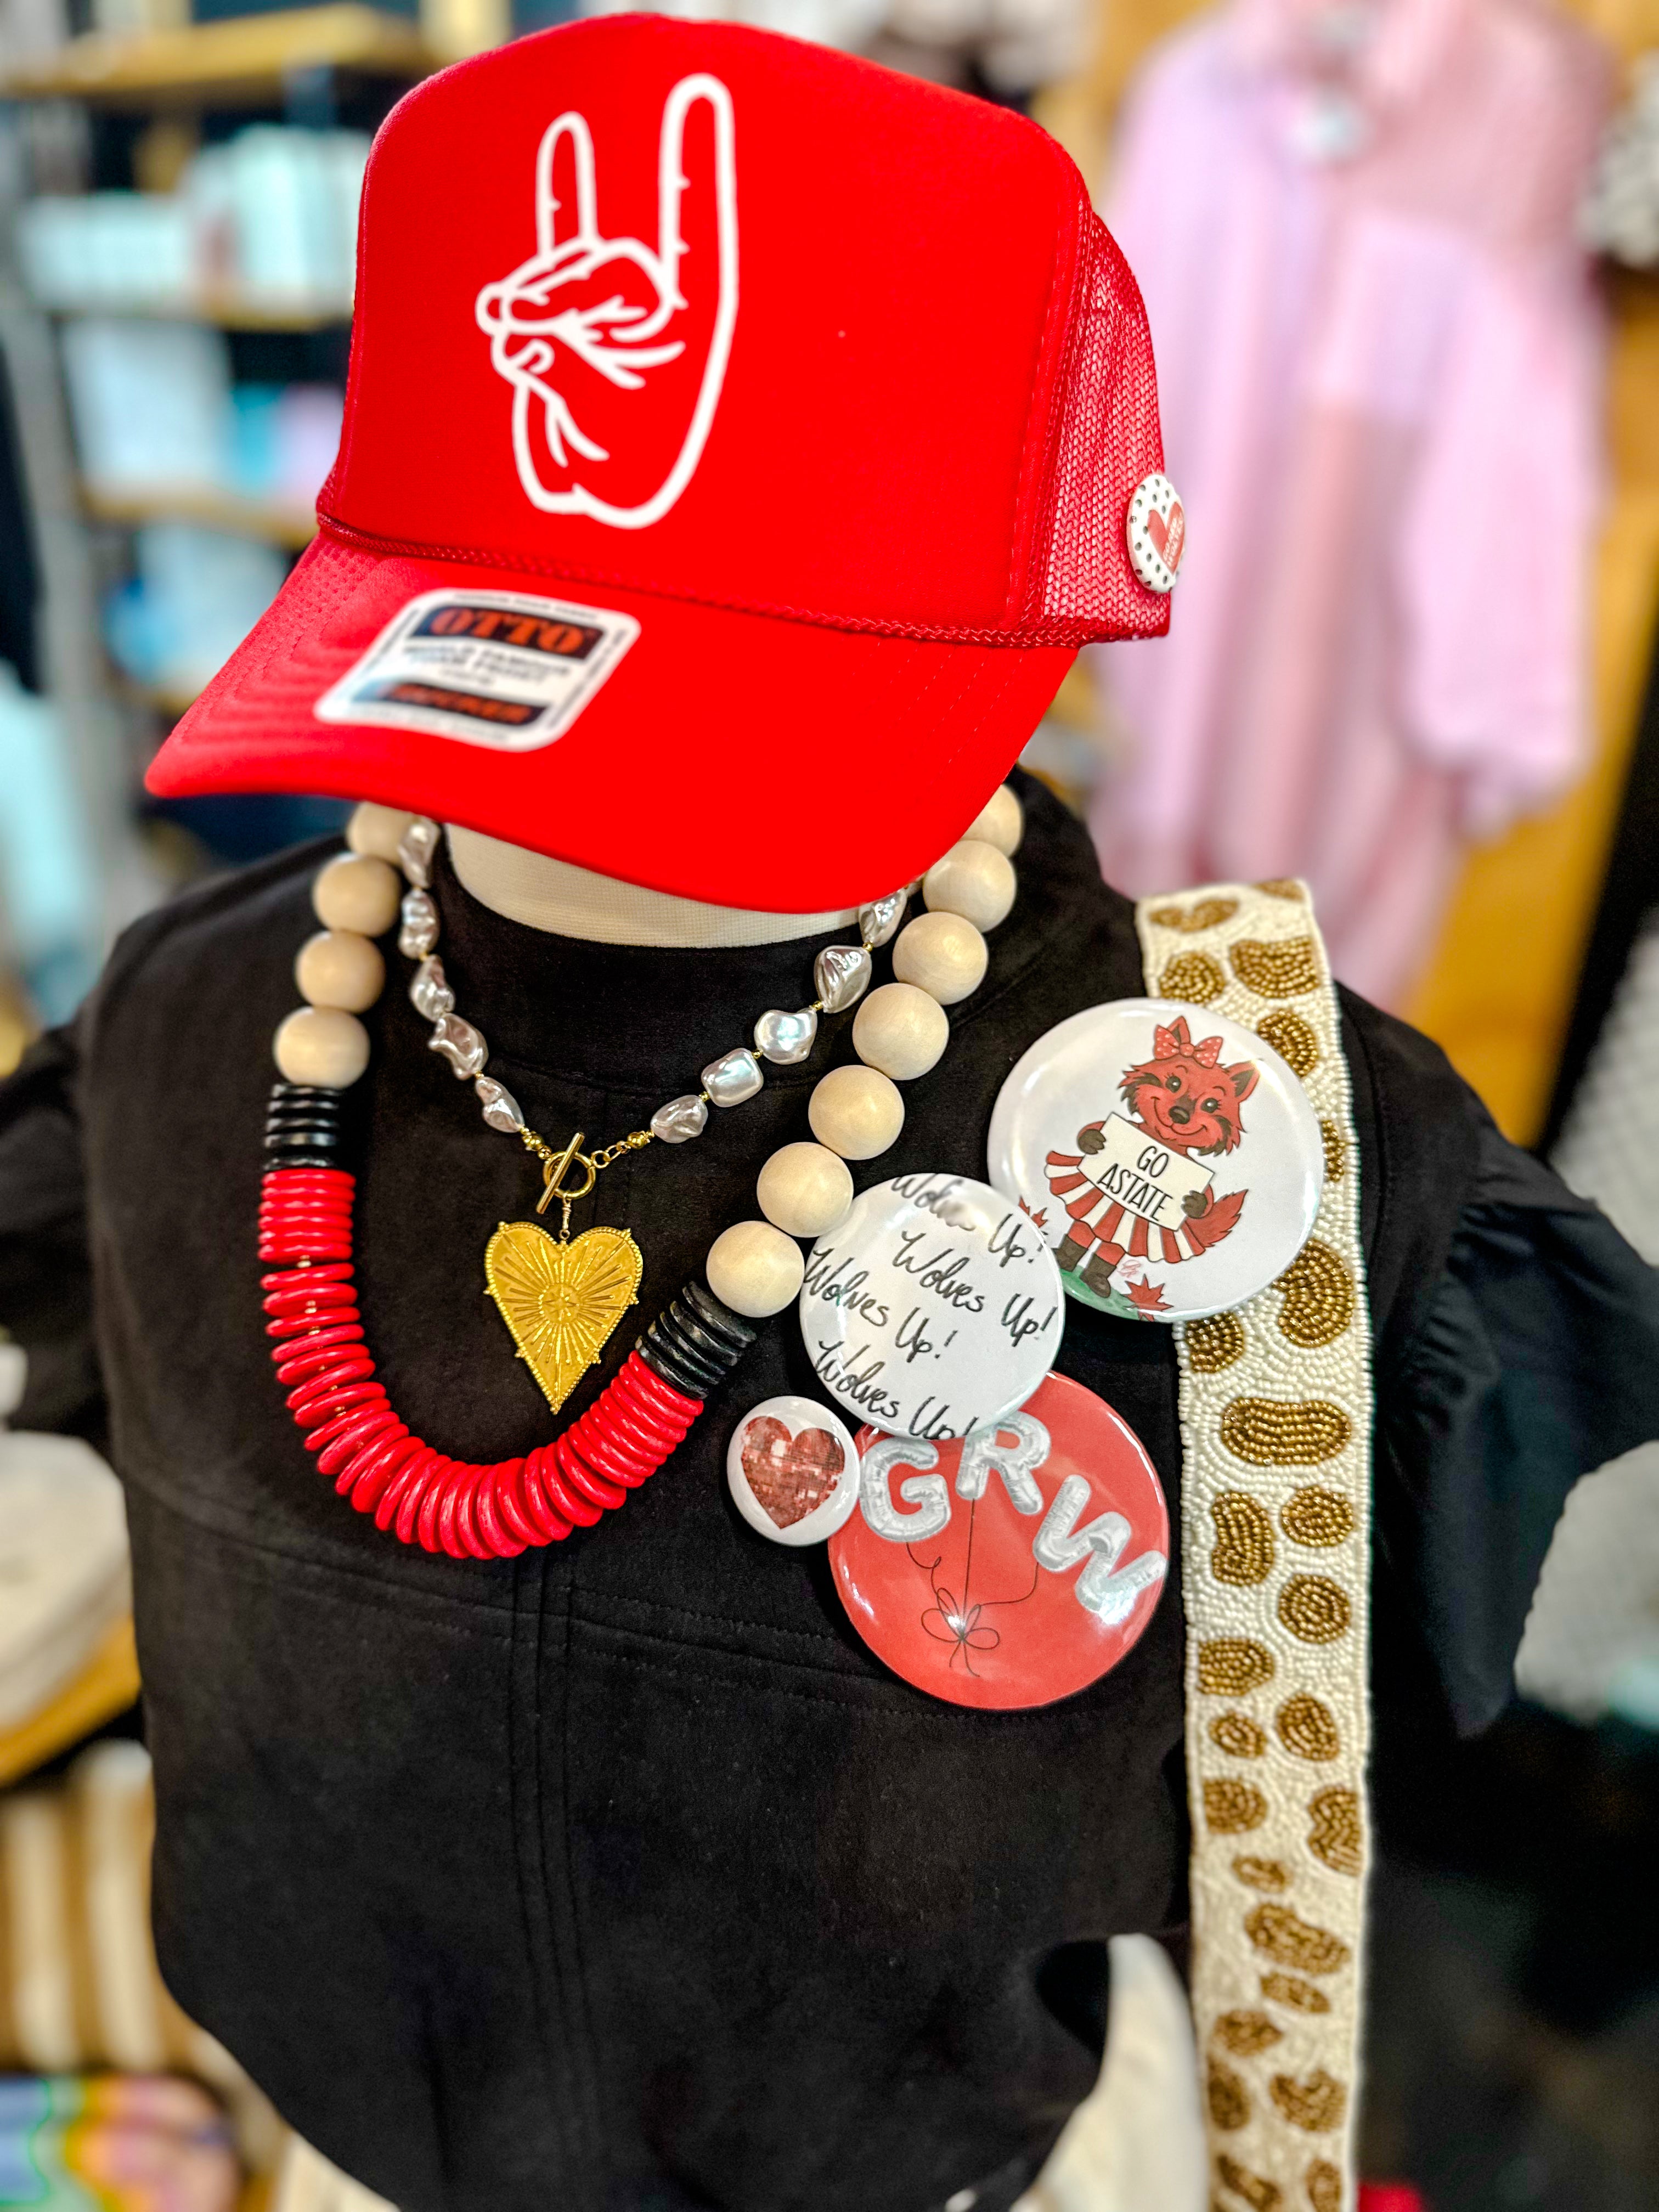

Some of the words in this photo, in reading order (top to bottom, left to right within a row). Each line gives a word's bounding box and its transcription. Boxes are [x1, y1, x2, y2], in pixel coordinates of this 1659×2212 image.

[430, 607, 585, 654] OTTO
[1096, 1163, 1173, 1221] ASTATE
[1136, 1146, 1169, 1178] GO
[988, 1214, 1045, 1267] Up!
[804, 1247, 890, 1327] Wolves
[895, 1307, 958, 1363] Up!
[892, 1230, 986, 1313] Wolves
[1000, 1293, 1058, 1347] Up!
[815, 1340, 901, 1419] Wolves
[859, 1410, 1167, 1620] GRW
